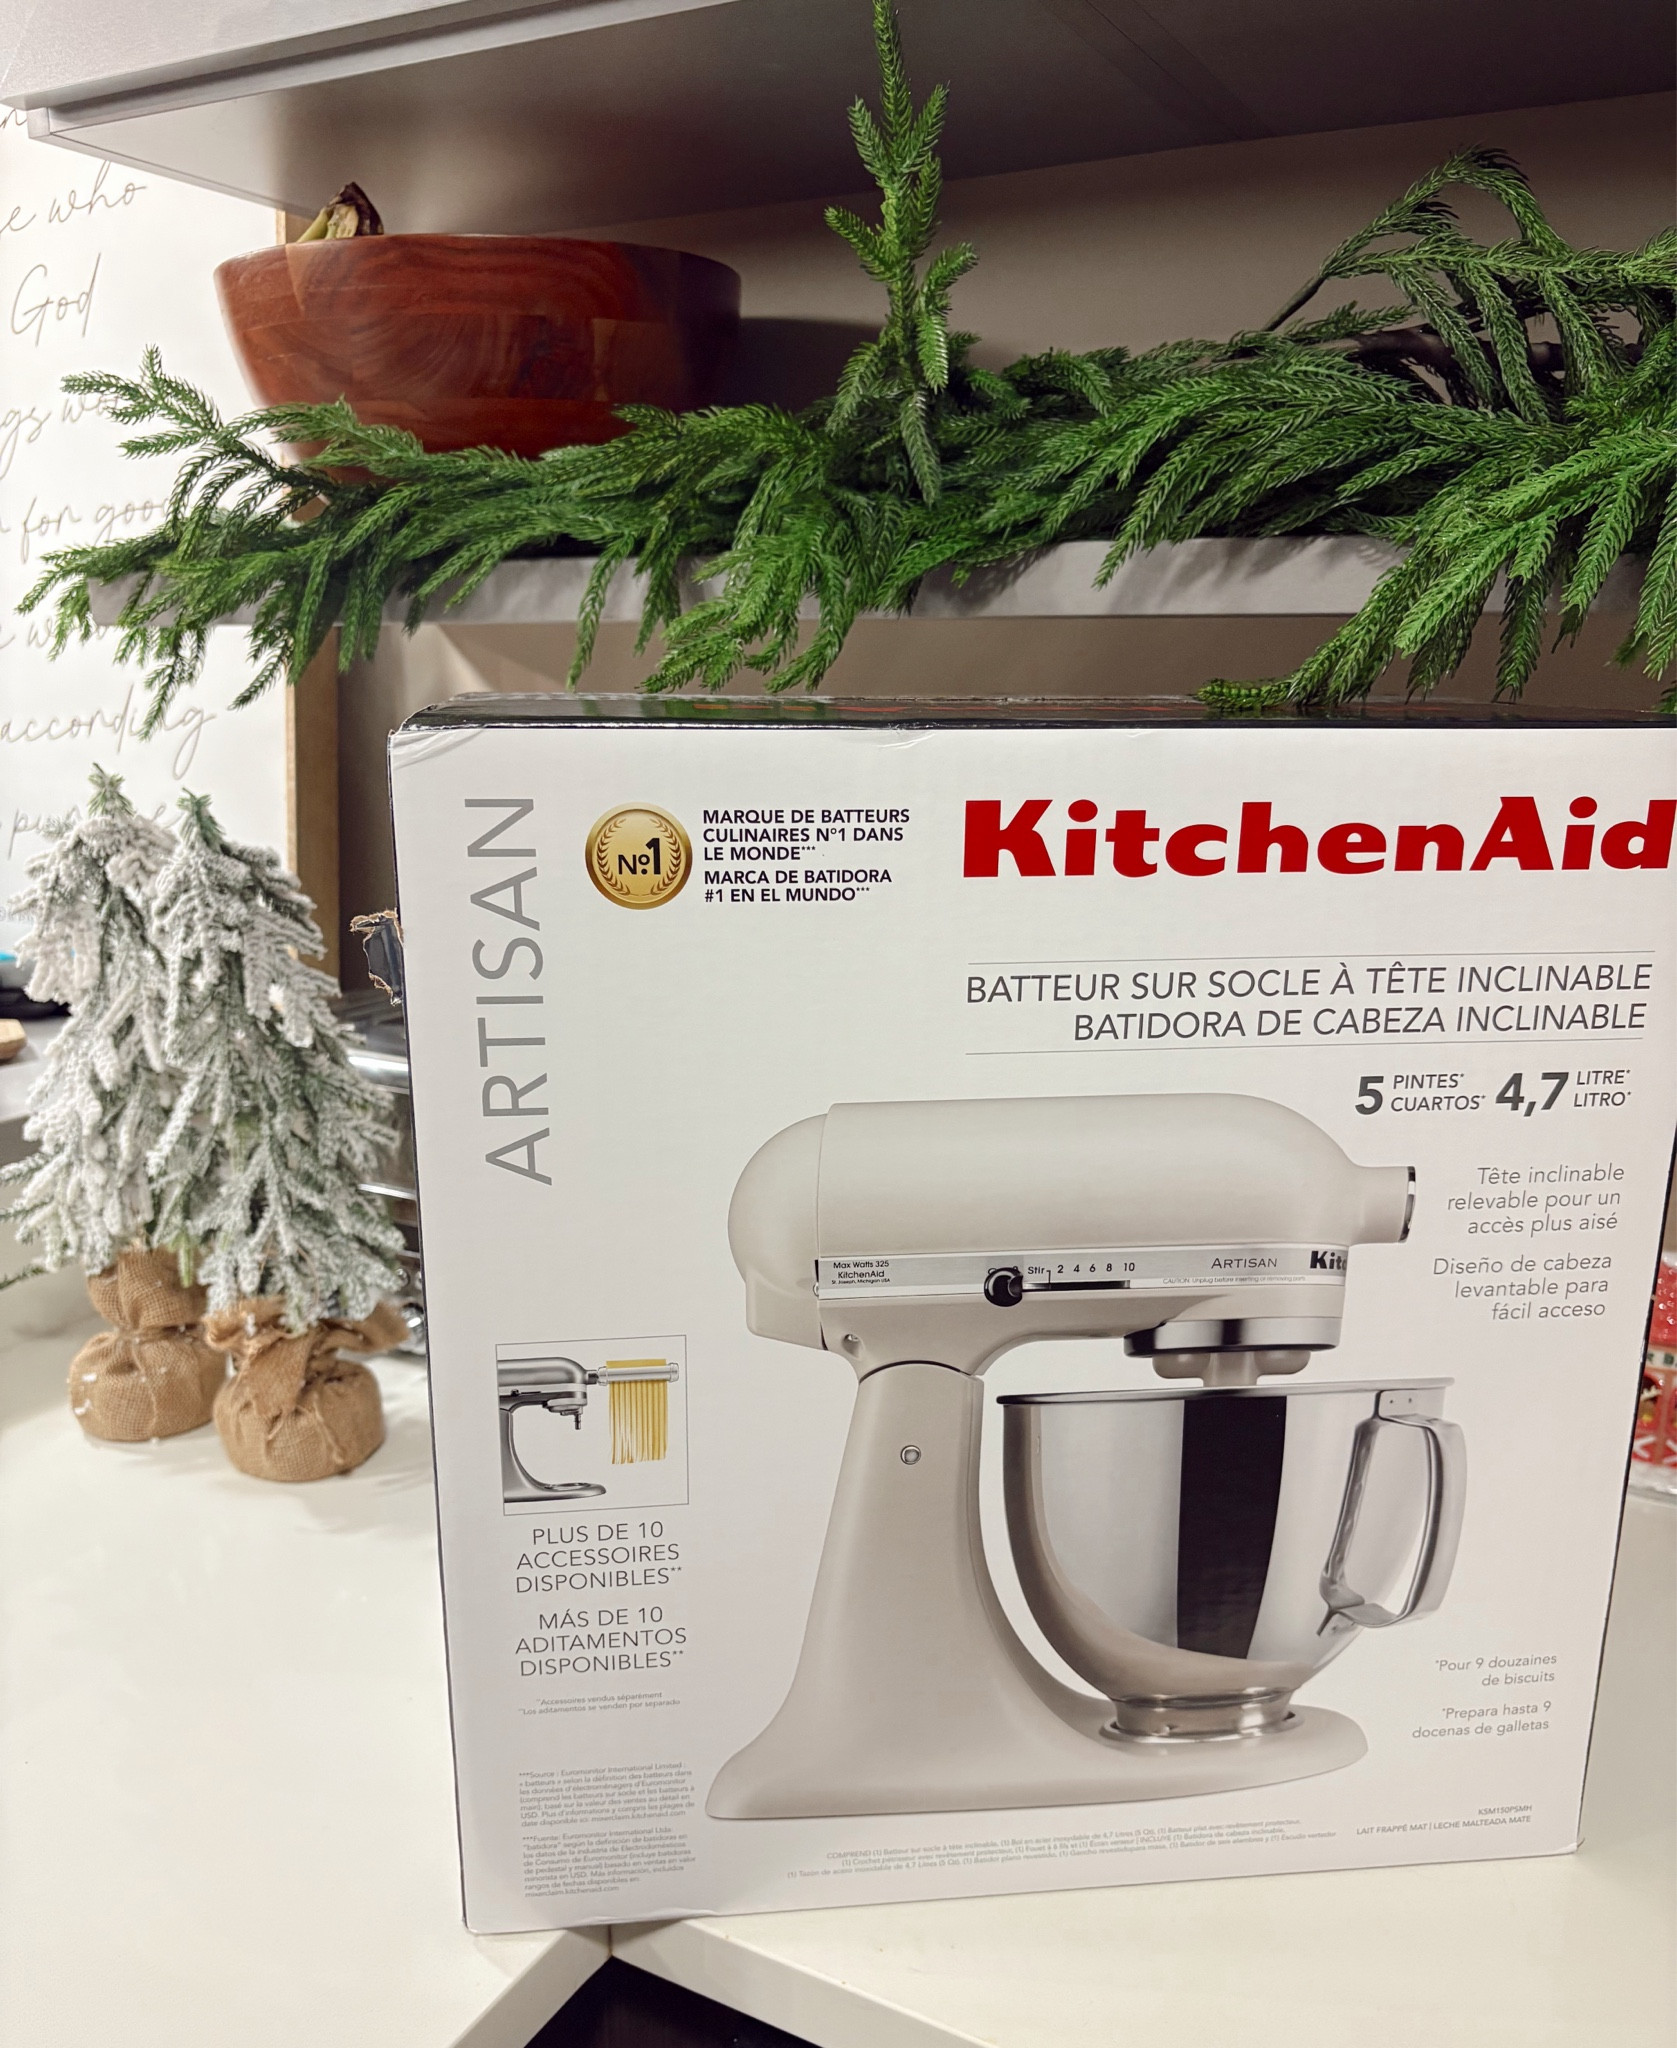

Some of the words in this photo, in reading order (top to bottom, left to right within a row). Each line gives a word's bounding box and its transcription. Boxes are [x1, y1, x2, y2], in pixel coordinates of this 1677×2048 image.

[49, 159, 146, 223] who
[11, 252, 100, 346] God
[21, 495, 81, 564] for
[703, 809, 784, 824] MARQUE
[791, 809, 815, 824] DE
[821, 808, 910, 823] BATTEURS
[703, 828, 810, 843] CULINAIRES
[854, 827, 904, 842] DANS
[963, 796, 1677, 878] KitchenAid
[704, 847, 724, 861] LE
[704, 870, 769, 885] MARCA
[775, 870, 799, 884] DE
[804, 869, 892, 884] BATIDORA
[704, 889, 724, 903] #1
[730, 888, 755, 903] EN
[761, 888, 781, 902] EL
[464, 798, 552, 1186] ARTISAN
[967, 973, 1120, 1003] BATTEUR
[1132, 971, 1196, 999] SUR
[1208, 969, 1320, 998] SOCLE
[1331, 962, 1356, 995] À
[1366, 961, 1446, 995] TÊTE
[1457, 964, 1653, 994] INCLINABLE
[1074, 1009, 1245, 1041] BATIDORA
[1258, 1008, 1302, 1037] DE
[1313, 1005, 1446, 1036] CABEZA
[1456, 1002, 1647, 1032] INCLINABLE
[1354, 1075, 1385, 1116] 5
[1495, 1072, 1570, 1117] 4,7
[1477, 1167, 1521, 1184] Tête
[1528, 1162, 1625, 1183] inclinable
[1447, 1190, 1539, 1210] relevable
[1544, 1194, 1593, 1213] pour
[1598, 1192, 1621, 1206] un
[1467, 1216, 1524, 1234] accès
[1530, 1213, 1573, 1238] plus
[1579, 1212, 1618, 1230] aisé
[875, 1260, 889, 1268] 325
[1027, 1266, 1045, 1275] Stir
[1057, 1264, 1064, 1274] 2
[1073, 1264, 1080, 1273] 4
[1089, 1264, 1096, 1273] 6
[1106, 1263, 1112, 1272] 8
[1123, 1262, 1135, 1272] 10
[1211, 1257, 1278, 1269] ARTISAN
[1433, 1257, 1503, 1275] Diseño
[1510, 1255, 1536, 1272] de
[1543, 1252, 1612, 1271] cabeza
[838, 1270, 885, 1279] KitchenAid
[1455, 1277, 1558, 1298] levantable
[1565, 1280, 1609, 1299] para
[1492, 1302, 1531, 1320] fácil
[1538, 1303, 1606, 1319] acceso
[533, 1525, 589, 1545] PLUS
[598, 1523, 629, 1541] DE
[639, 1521, 663, 1539] 10
[516, 1543, 680, 1570] ACCESSOIRES
[539, 1608, 589, 1630] MÁS
[598, 1608, 629, 1626] DE
[639, 1606, 663, 1624] 10
[515, 1627, 687, 1655] ADITAMENTOS
[1475, 1657, 1484, 1669] 9
[1488, 1654, 1557, 1669] douzaines
[1481, 1674, 1500, 1686] de
[1504, 1671, 1555, 1685] biscuits
[538, 1705, 586, 1714] aditamentos
[598, 1702, 628, 1710] venden
[629, 1701, 643, 1710] por
[644, 1699, 681, 1708] separado
[587, 1694, 615, 1703] vendus
[1503, 1703, 1538, 1716] hasta
[1543, 1700, 1552, 1712] 9
[1412, 1726, 1471, 1739] docenas
[1474, 1723, 1493, 1735] de
[1496, 1720, 1549, 1736] galletas
[1409, 1822, 1428, 1832] MAT
[1433, 1820, 1460, 1830] LECHE
[1462, 1817, 1507, 1828] MALTEADA
[1509, 1815, 1532, 1824] MATE
